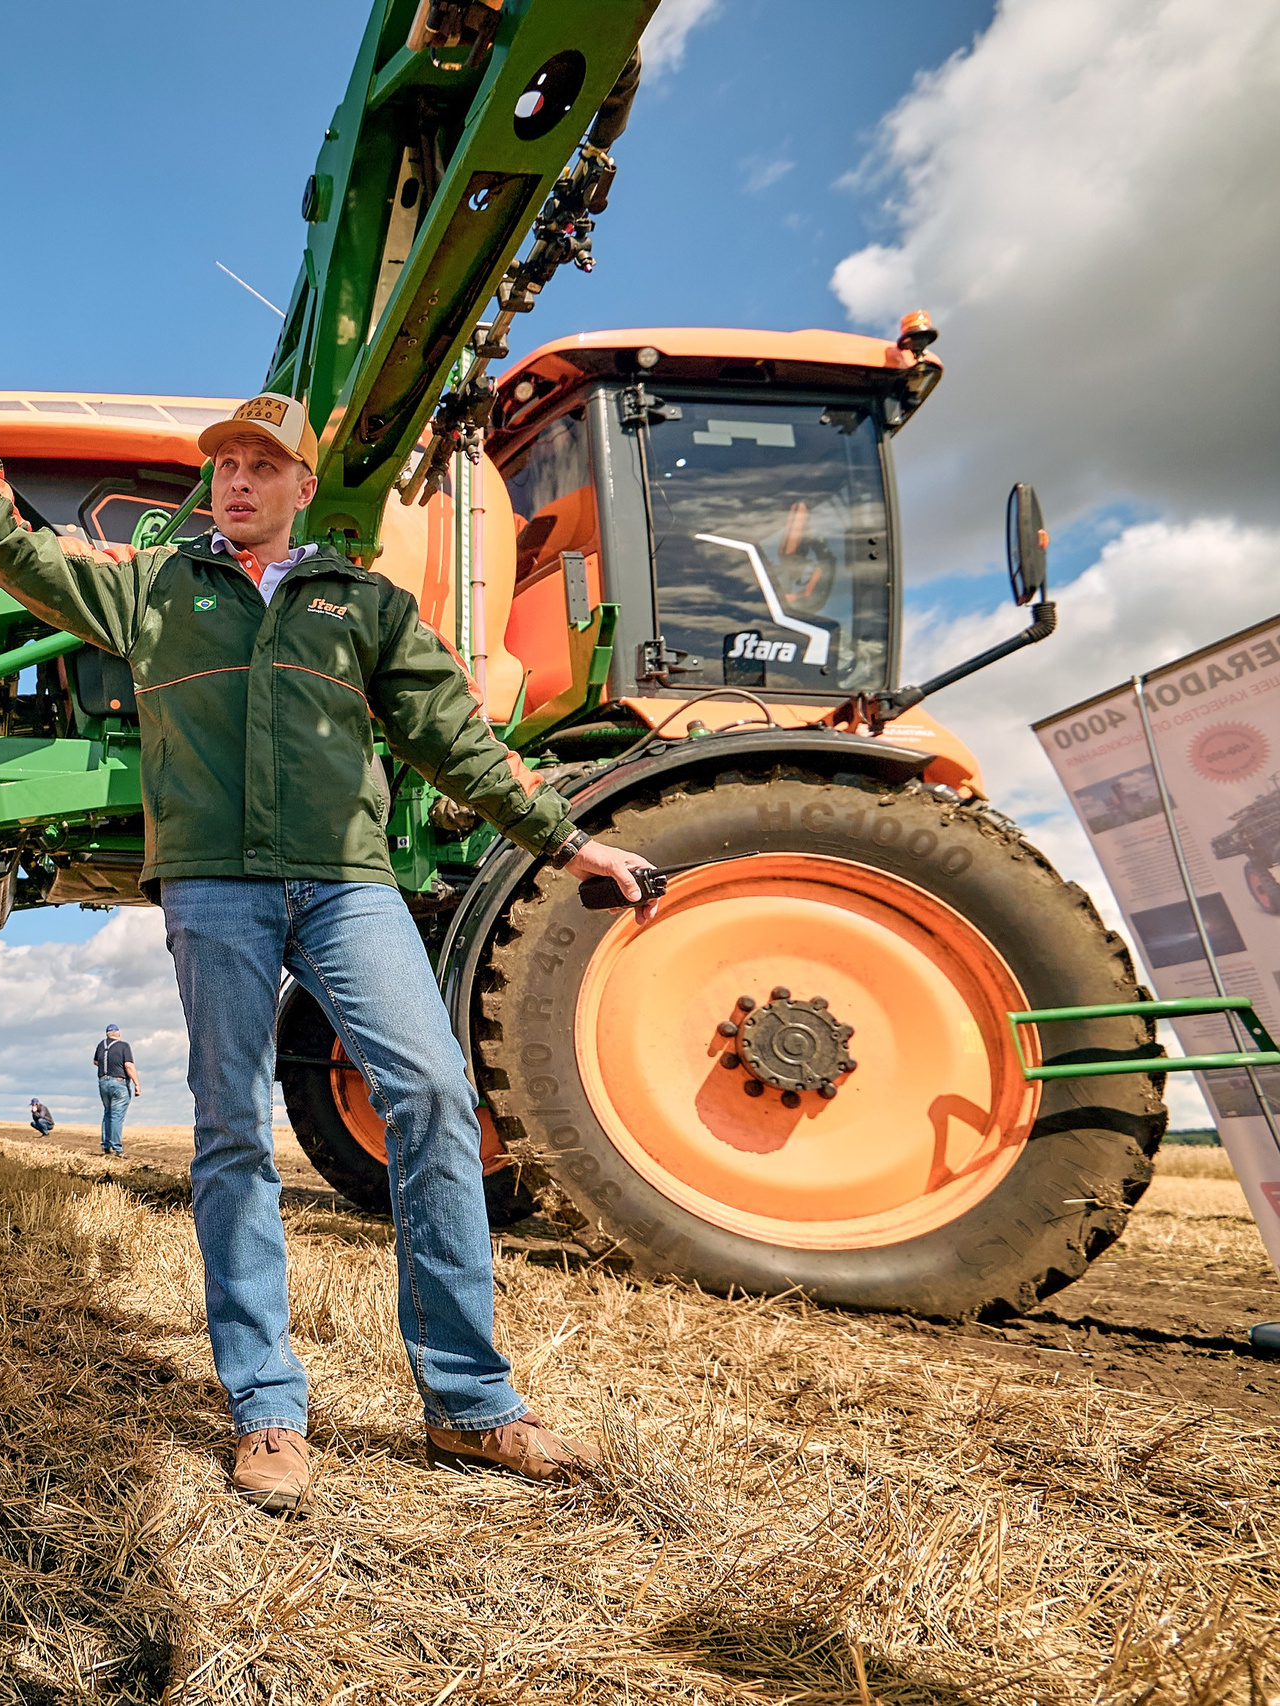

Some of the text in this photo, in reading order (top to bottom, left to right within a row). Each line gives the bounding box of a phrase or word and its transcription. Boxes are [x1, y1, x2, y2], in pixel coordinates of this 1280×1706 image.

[240, 410, 272, 419] 1960
[308, 598, 348, 616] Stara
[727, 633, 797, 663] Stara
[520, 920, 697, 1271] VF 380/90 R 46
